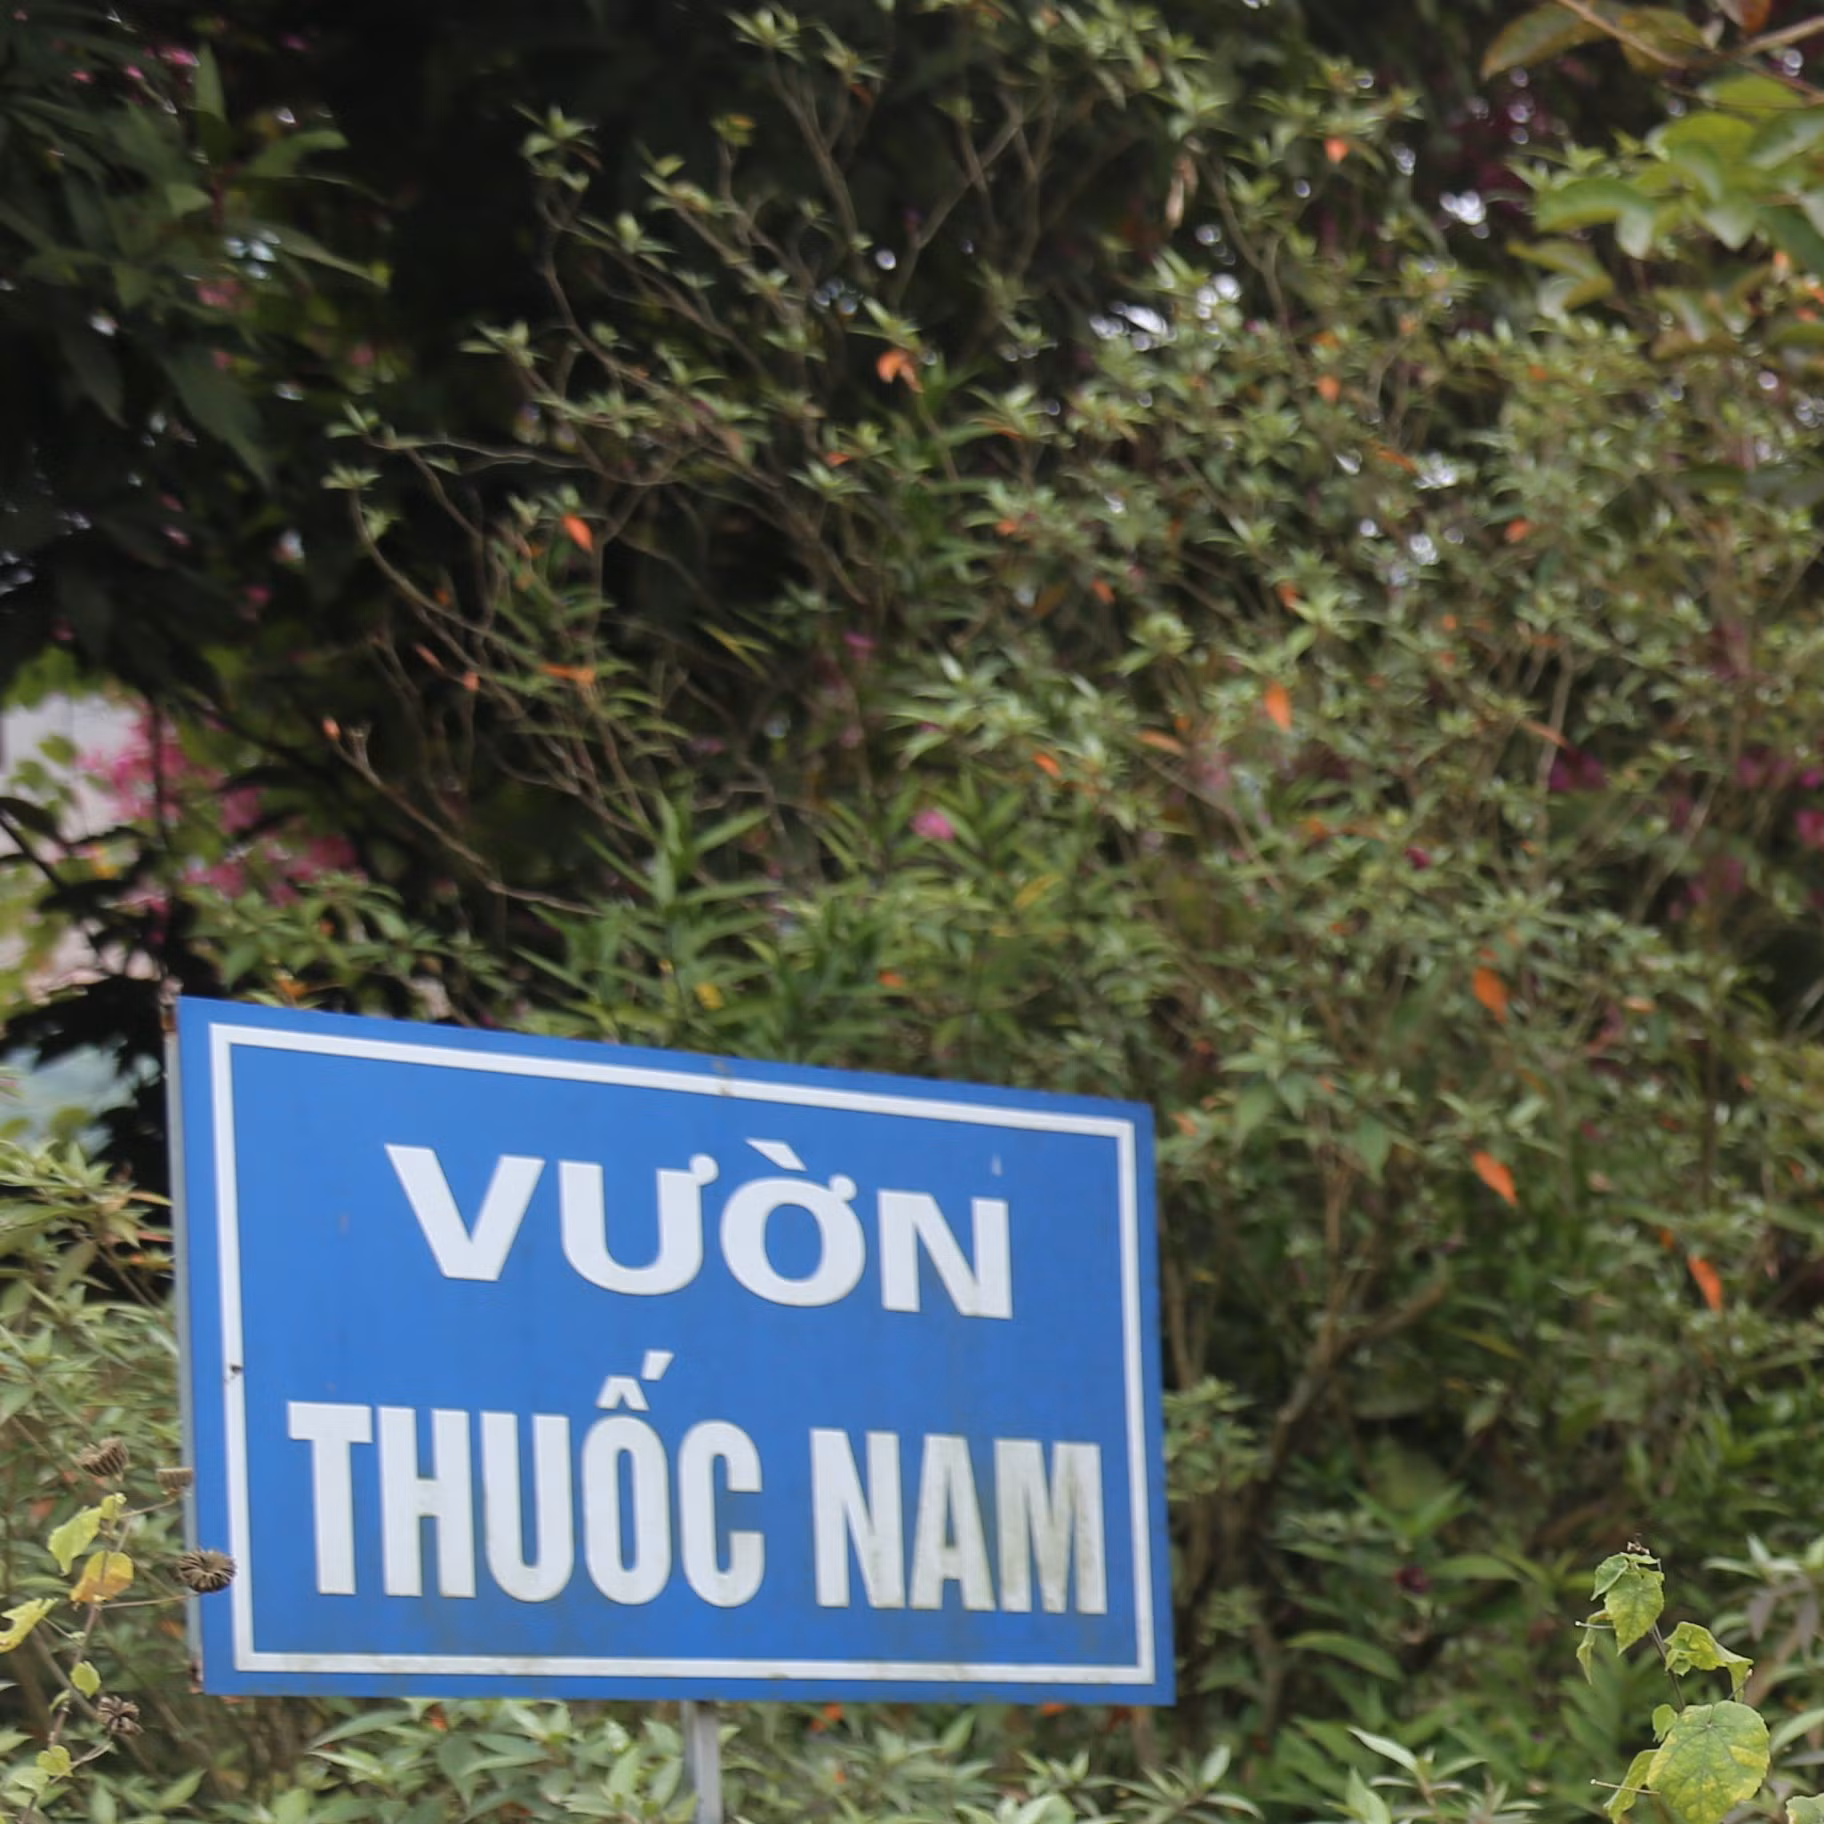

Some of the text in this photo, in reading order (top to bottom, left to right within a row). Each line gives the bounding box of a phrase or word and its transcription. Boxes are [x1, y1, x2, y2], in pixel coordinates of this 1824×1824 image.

[385, 1136, 1013, 1320] VƯỜN
[287, 1350, 1107, 1615] THUỐC NAM
